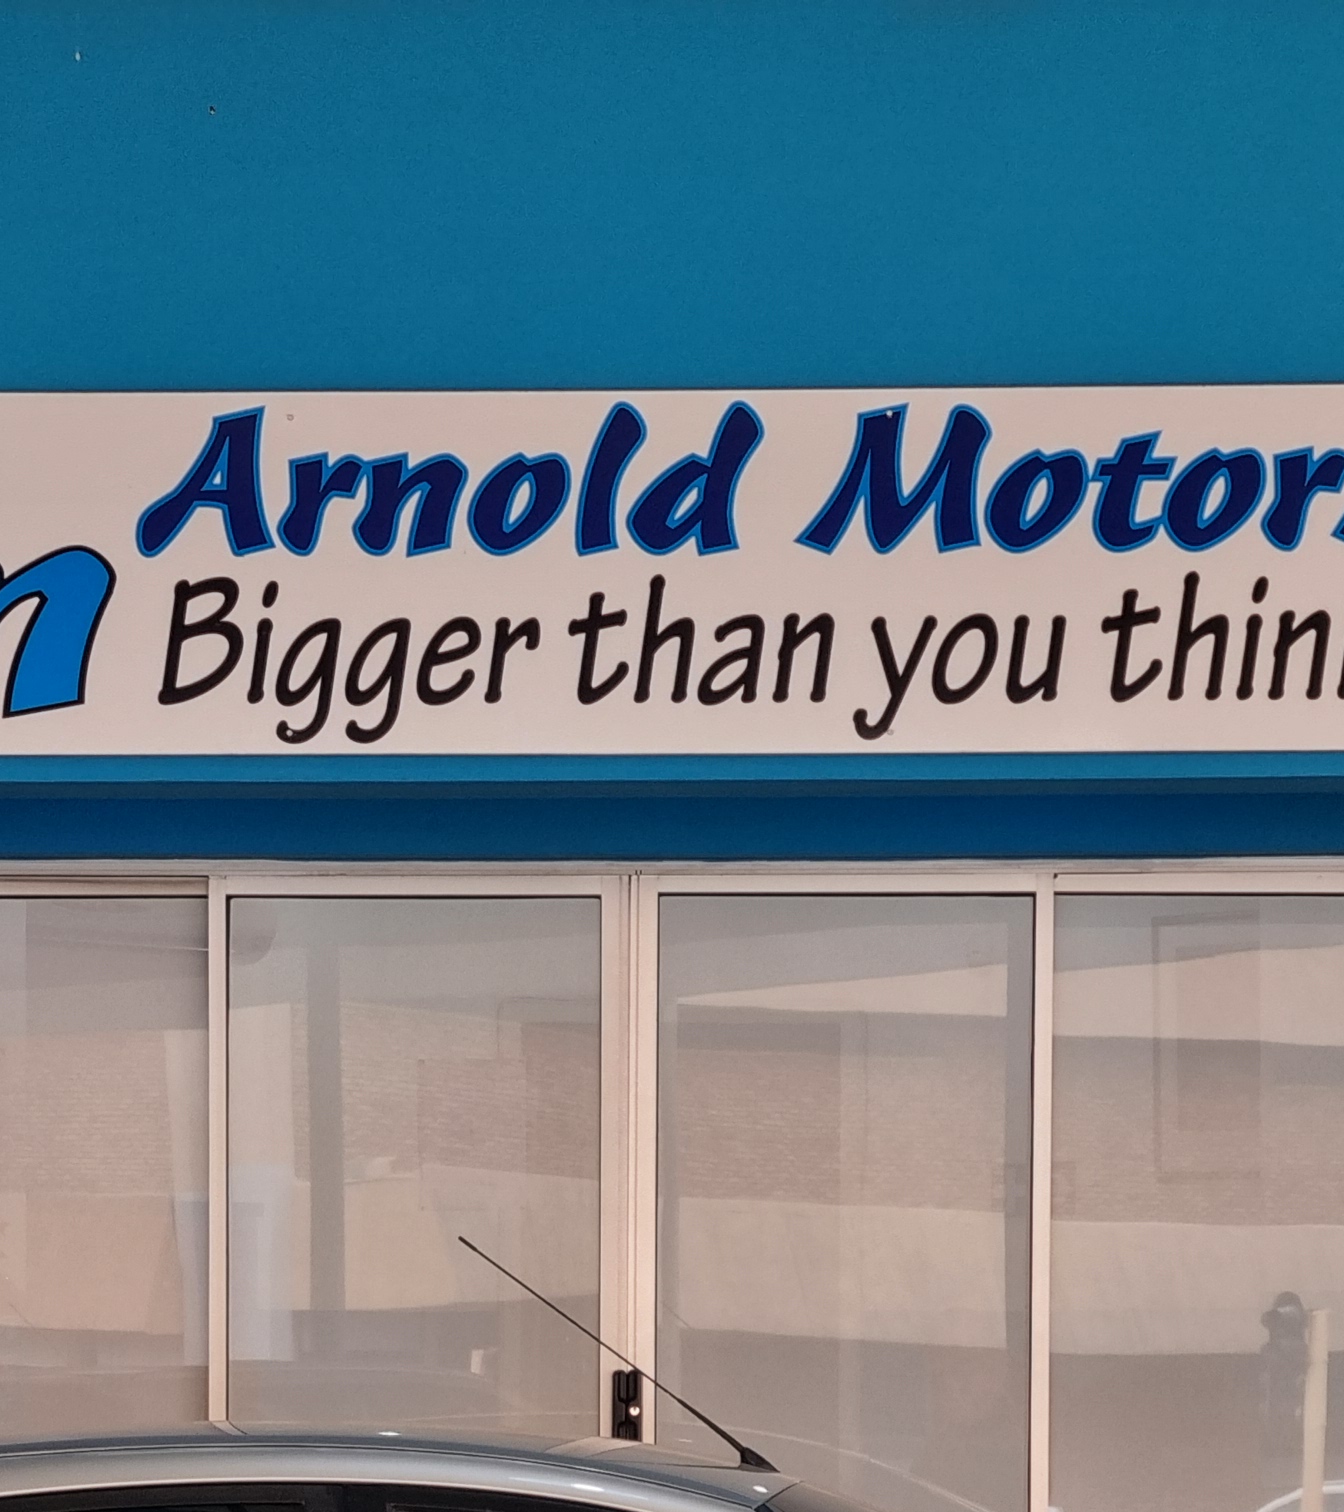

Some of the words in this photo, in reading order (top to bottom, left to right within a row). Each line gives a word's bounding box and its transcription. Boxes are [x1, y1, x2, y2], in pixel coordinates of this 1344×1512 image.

[135, 401, 765, 559] Arnold
[158, 577, 541, 745] Bigger
[568, 574, 837, 707] than
[853, 613, 1067, 741] you
